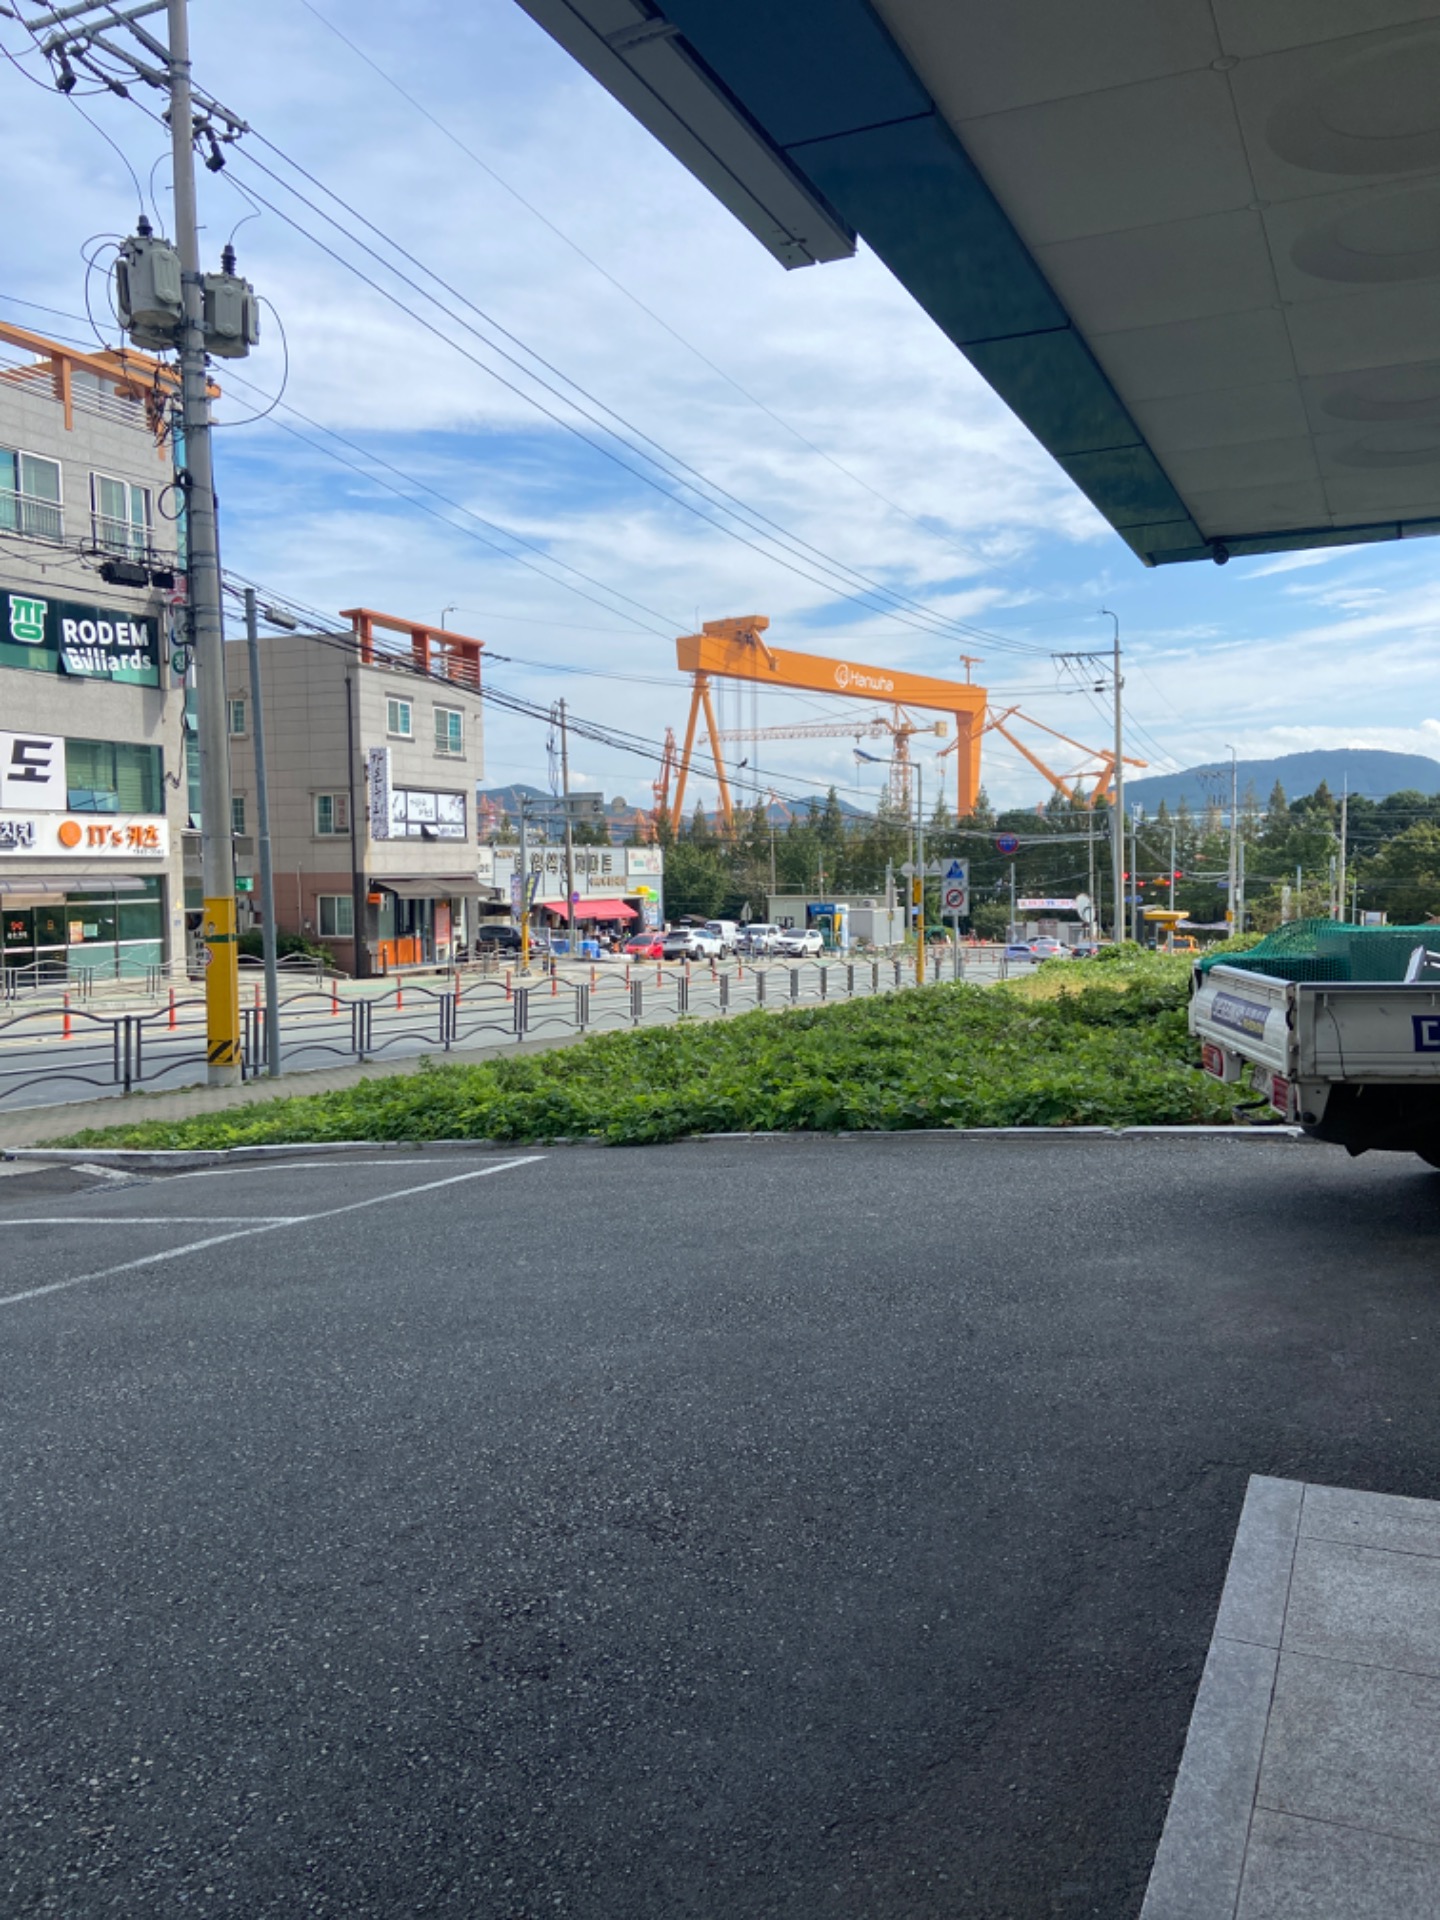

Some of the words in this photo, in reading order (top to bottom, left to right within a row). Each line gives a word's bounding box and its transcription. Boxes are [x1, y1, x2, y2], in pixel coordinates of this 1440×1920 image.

[62, 619, 149, 646] RODEM
[66, 647, 151, 672] Billiards
[8, 739, 53, 783] 도
[87, 824, 123, 847] IT's
